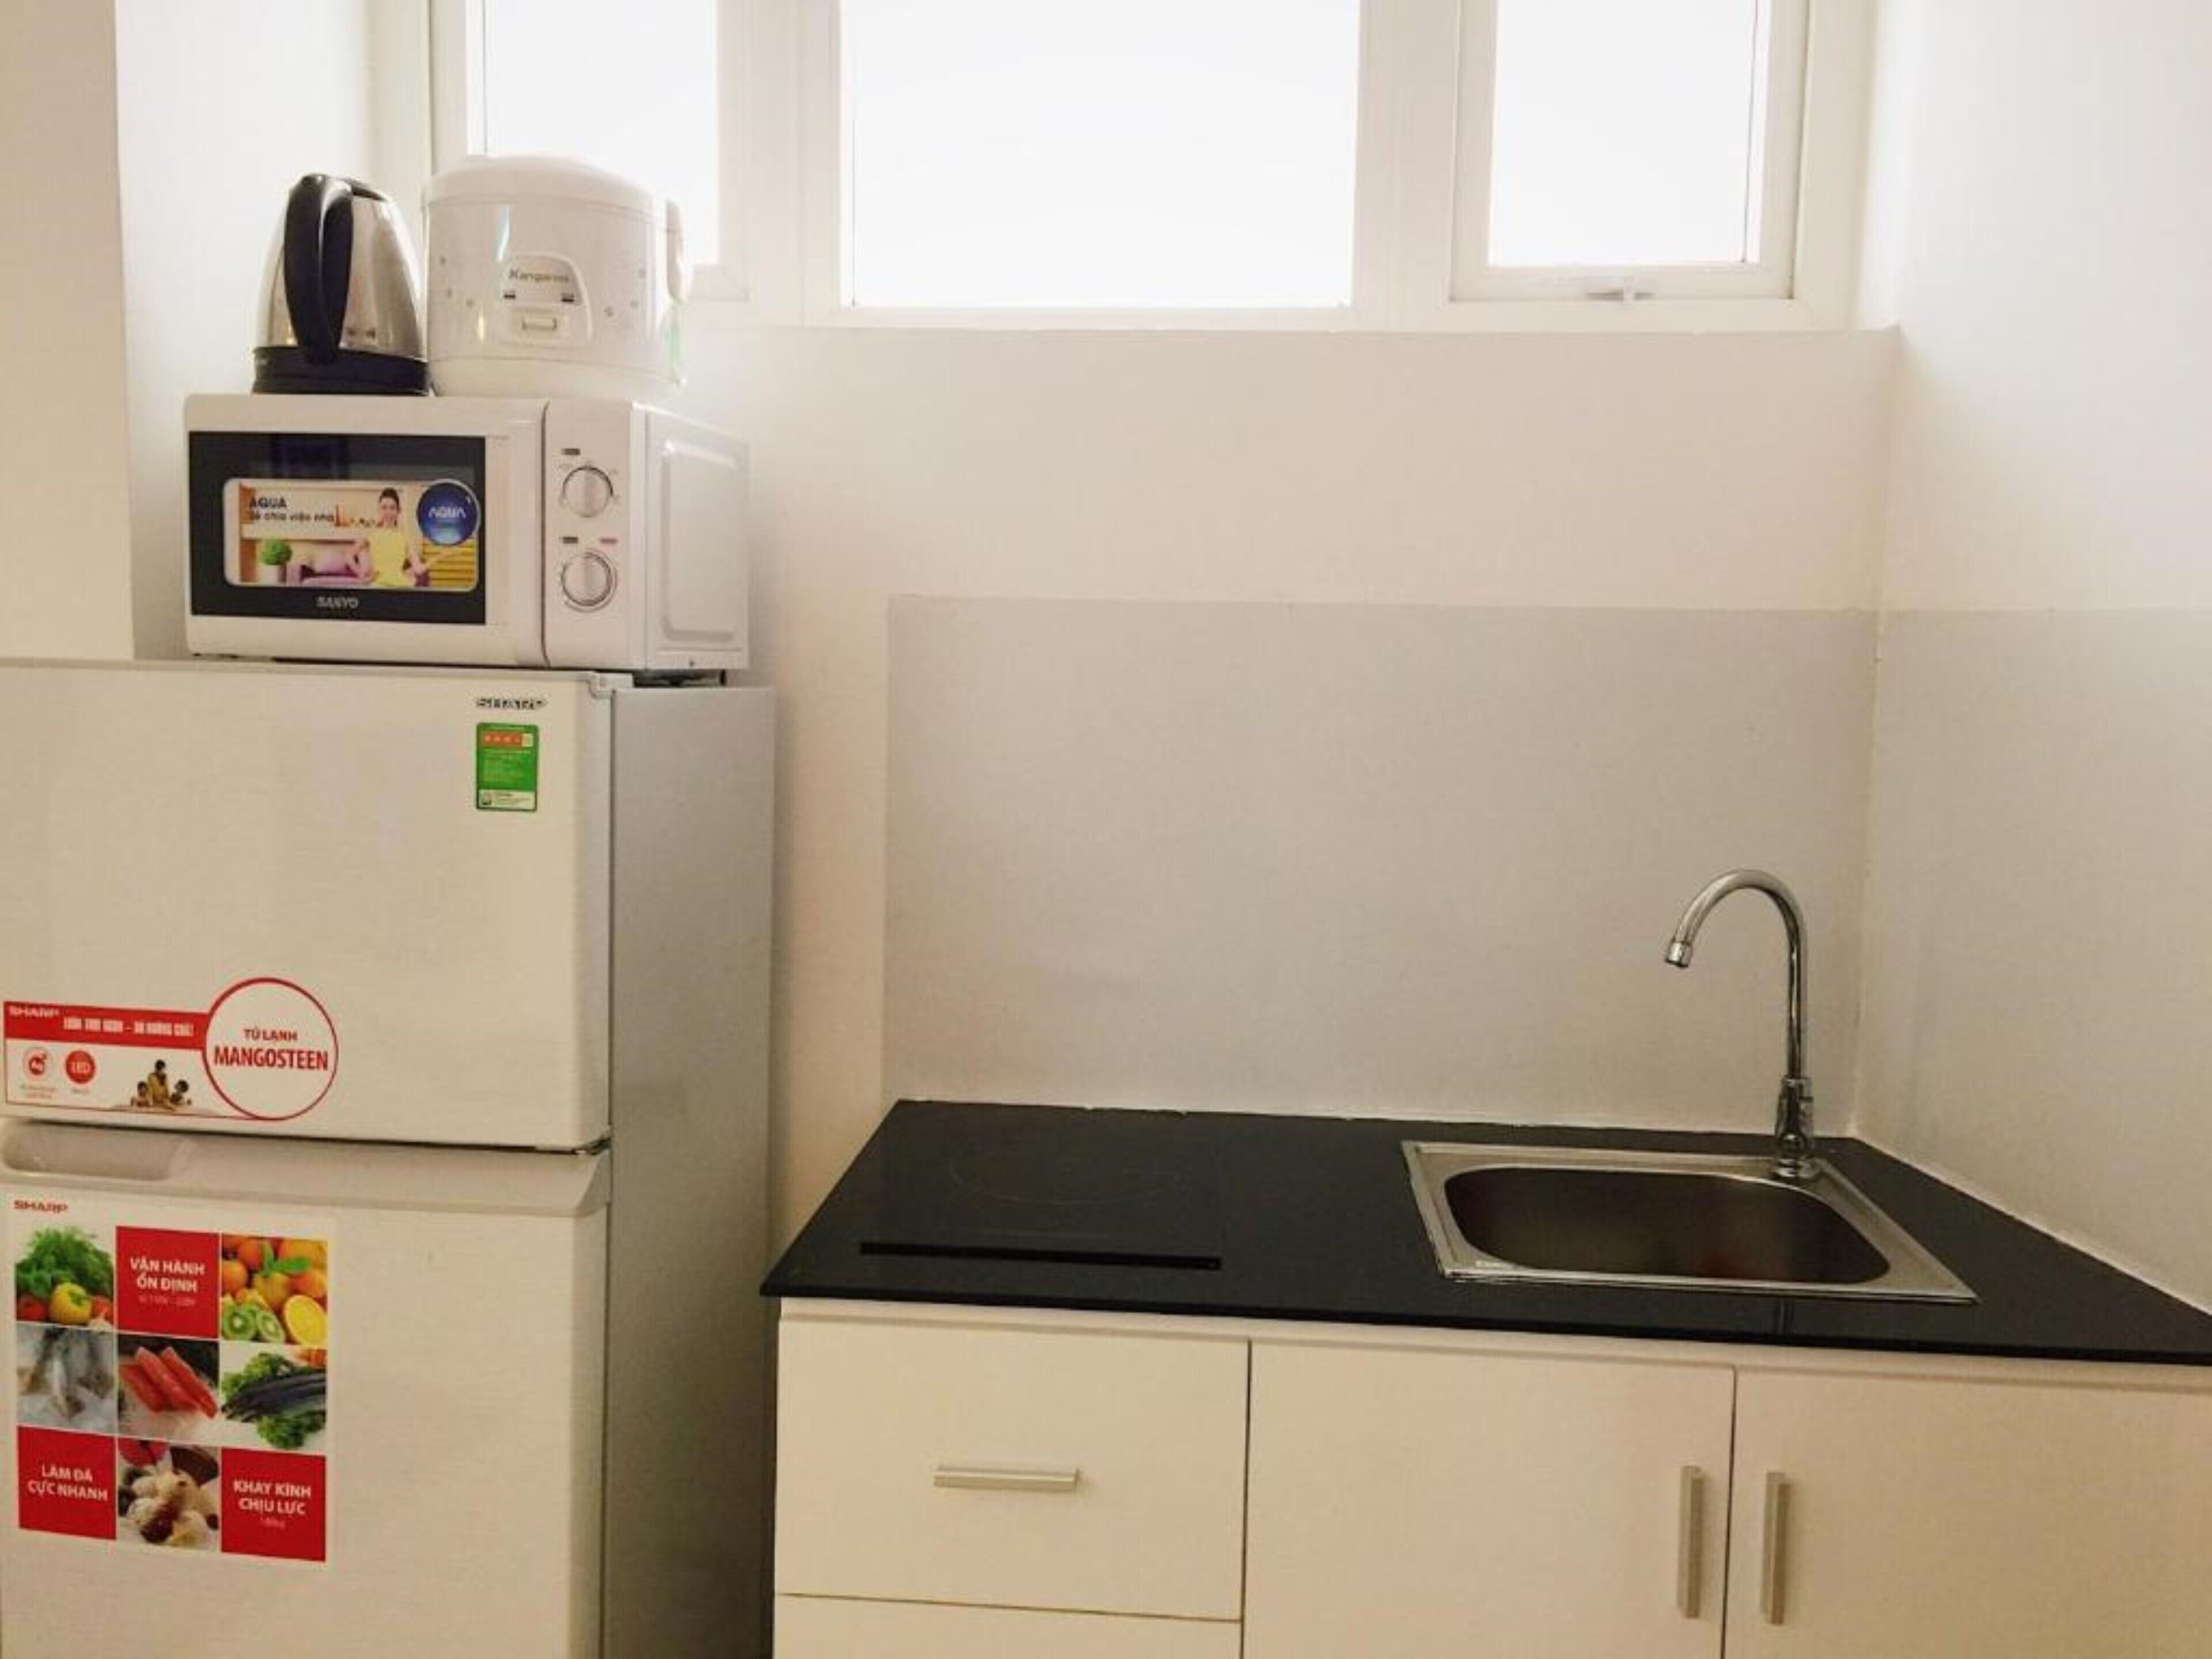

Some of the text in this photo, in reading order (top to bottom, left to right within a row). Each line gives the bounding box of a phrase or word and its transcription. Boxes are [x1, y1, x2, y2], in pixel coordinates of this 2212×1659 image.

[249, 497, 287, 508] AQUA
[215, 1046, 328, 1070] MANGOSTEEN
[14, 1200, 69, 1213] SHARP
[58, 1483, 108, 1501] NHANH
[233, 1480, 272, 1495] KHAY
